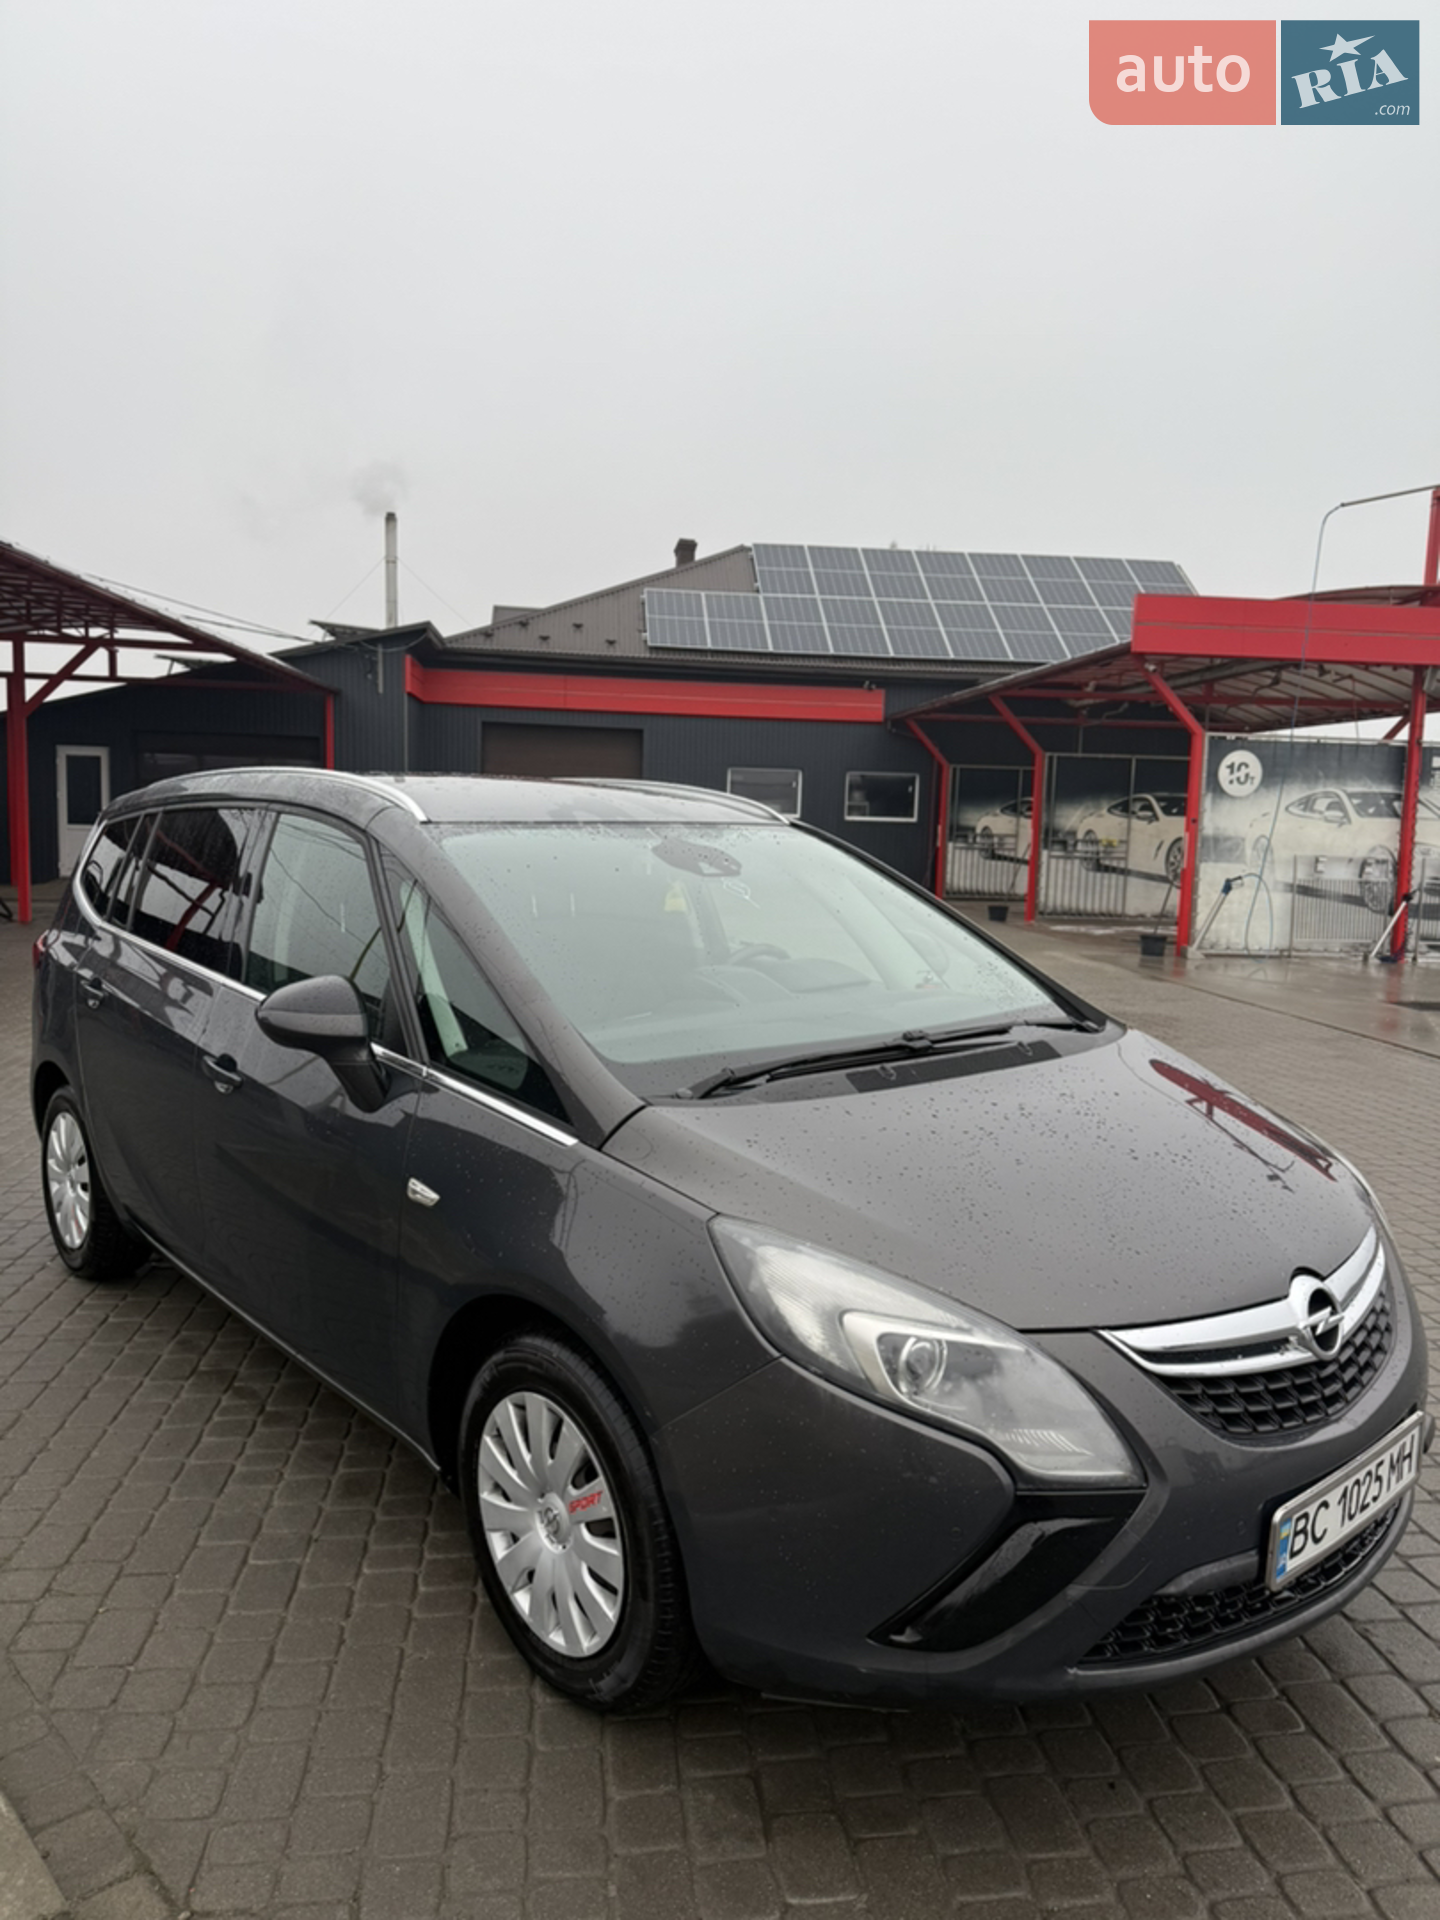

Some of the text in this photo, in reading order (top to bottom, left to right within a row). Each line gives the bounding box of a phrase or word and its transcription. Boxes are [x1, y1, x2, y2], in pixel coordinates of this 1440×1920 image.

[568, 1489, 604, 1514] SPORT
[1289, 1434, 1416, 1560] BC 1025 MH
